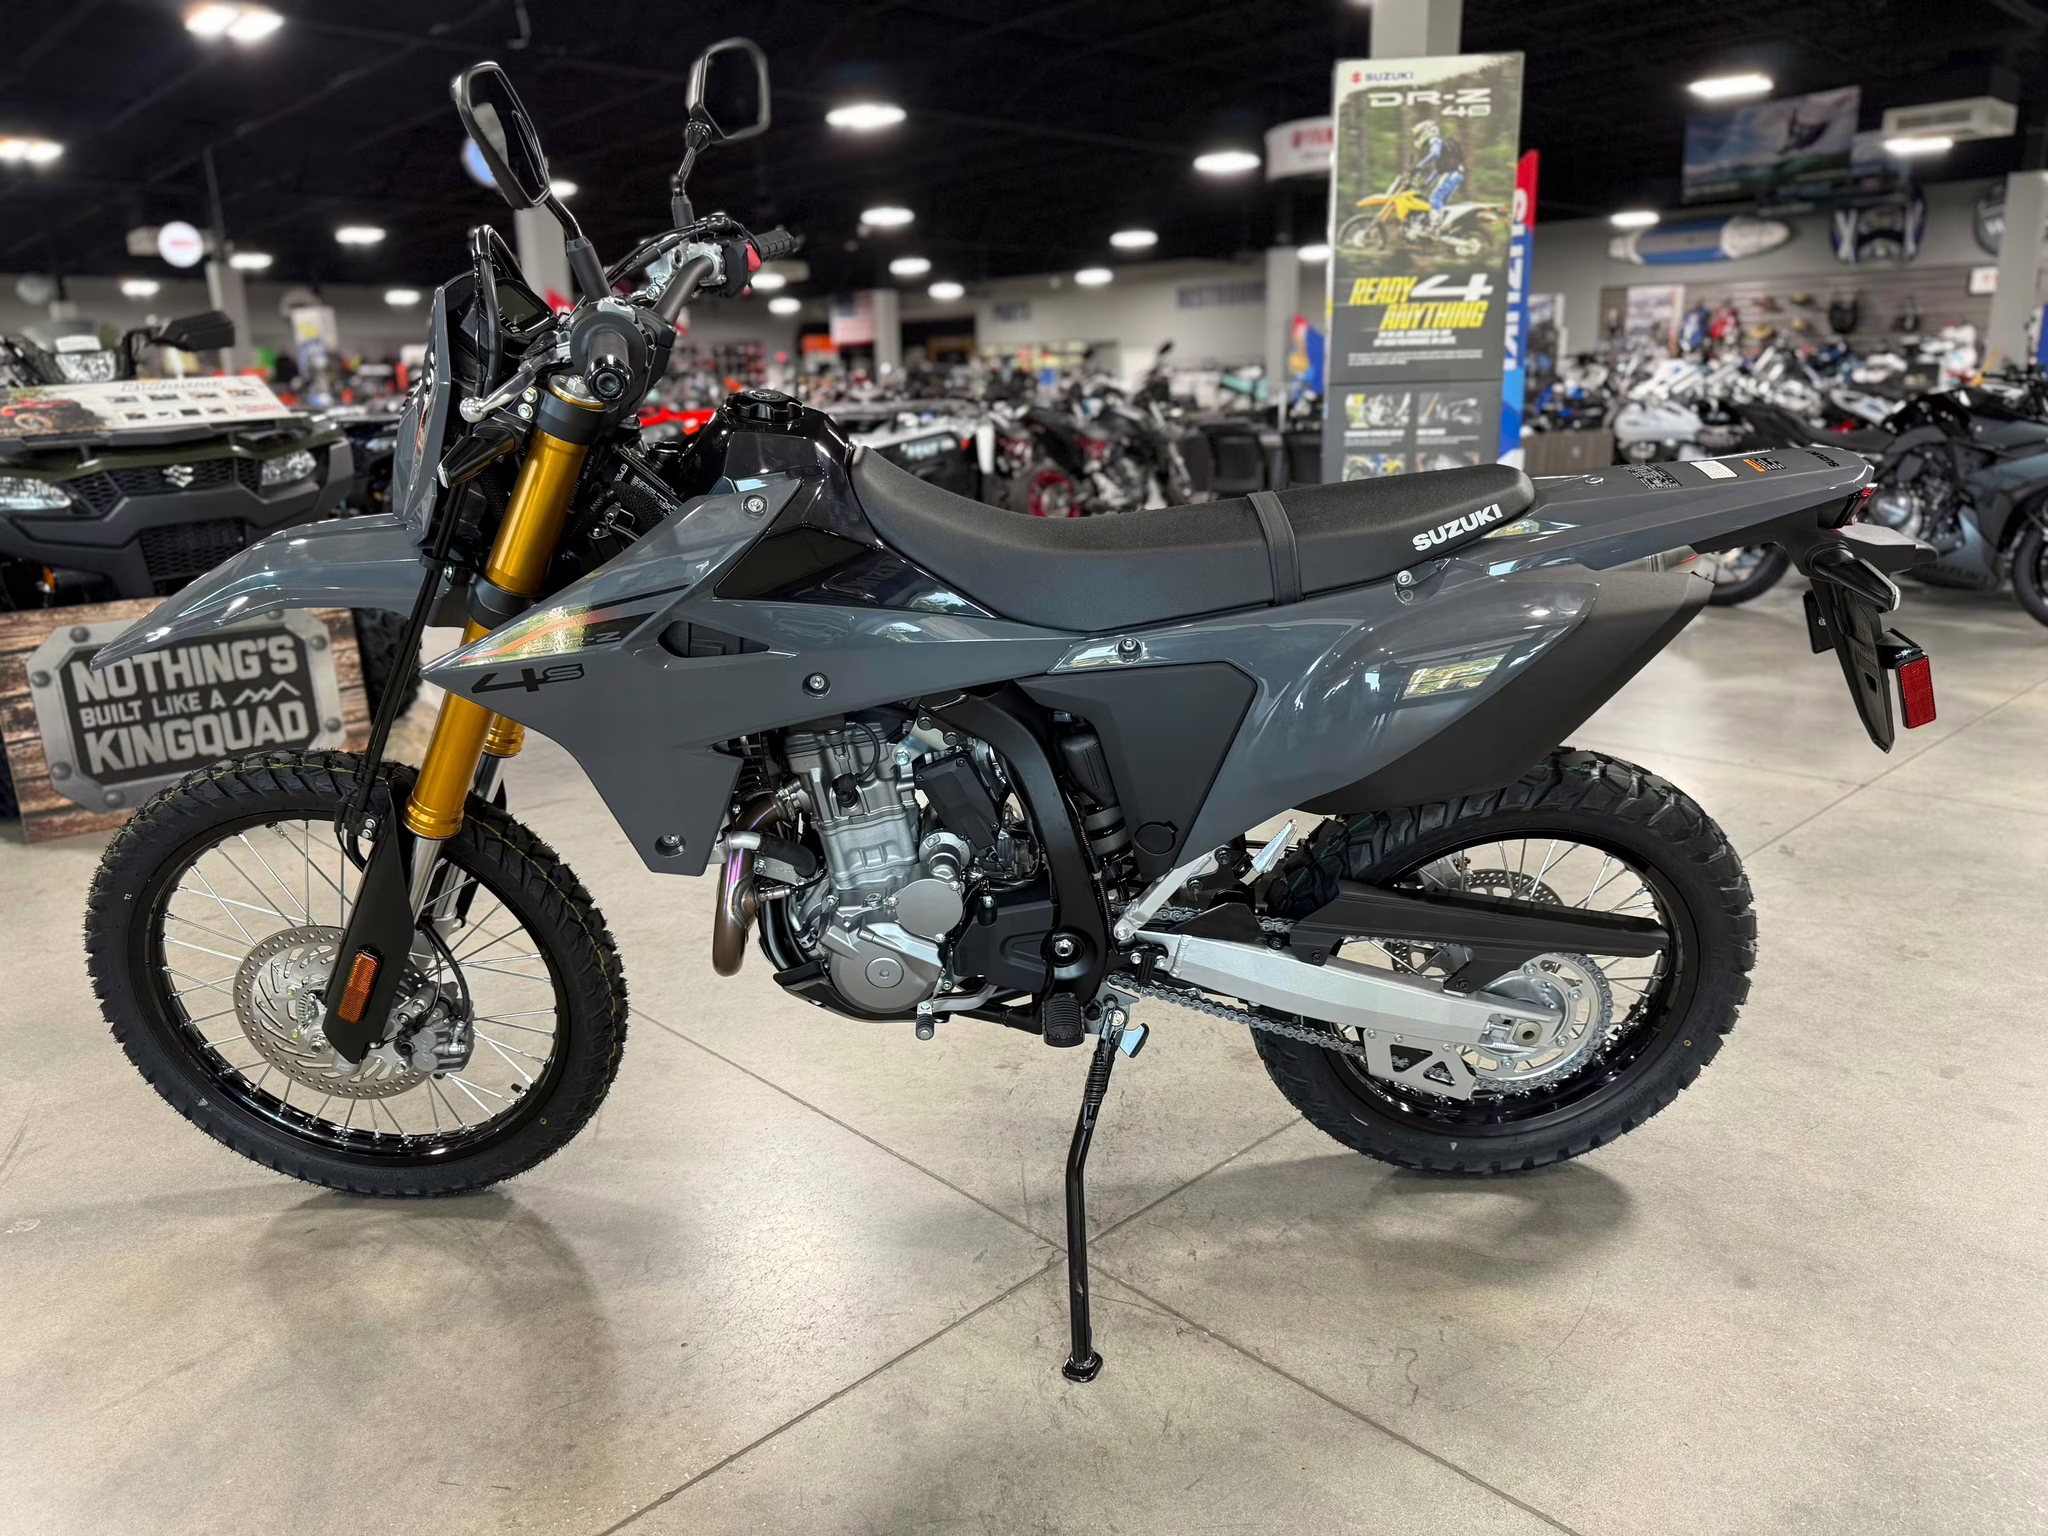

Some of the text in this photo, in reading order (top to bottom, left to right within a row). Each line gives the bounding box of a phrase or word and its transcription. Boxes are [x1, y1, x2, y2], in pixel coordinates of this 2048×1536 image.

[1365, 71, 1415, 82] SUZUKI
[1368, 88, 1492, 108] DR-Z
[1349, 273, 1494, 306] READY 4
[1380, 301, 1489, 330] ANYTHING
[1412, 503, 1504, 551] SUZUKI
[71, 635, 298, 702] NOTHING'S
[471, 663, 585, 694] 4S
[80, 689, 227, 729] BUILT LIKE A
[84, 702, 310, 775] KINGQUAD
